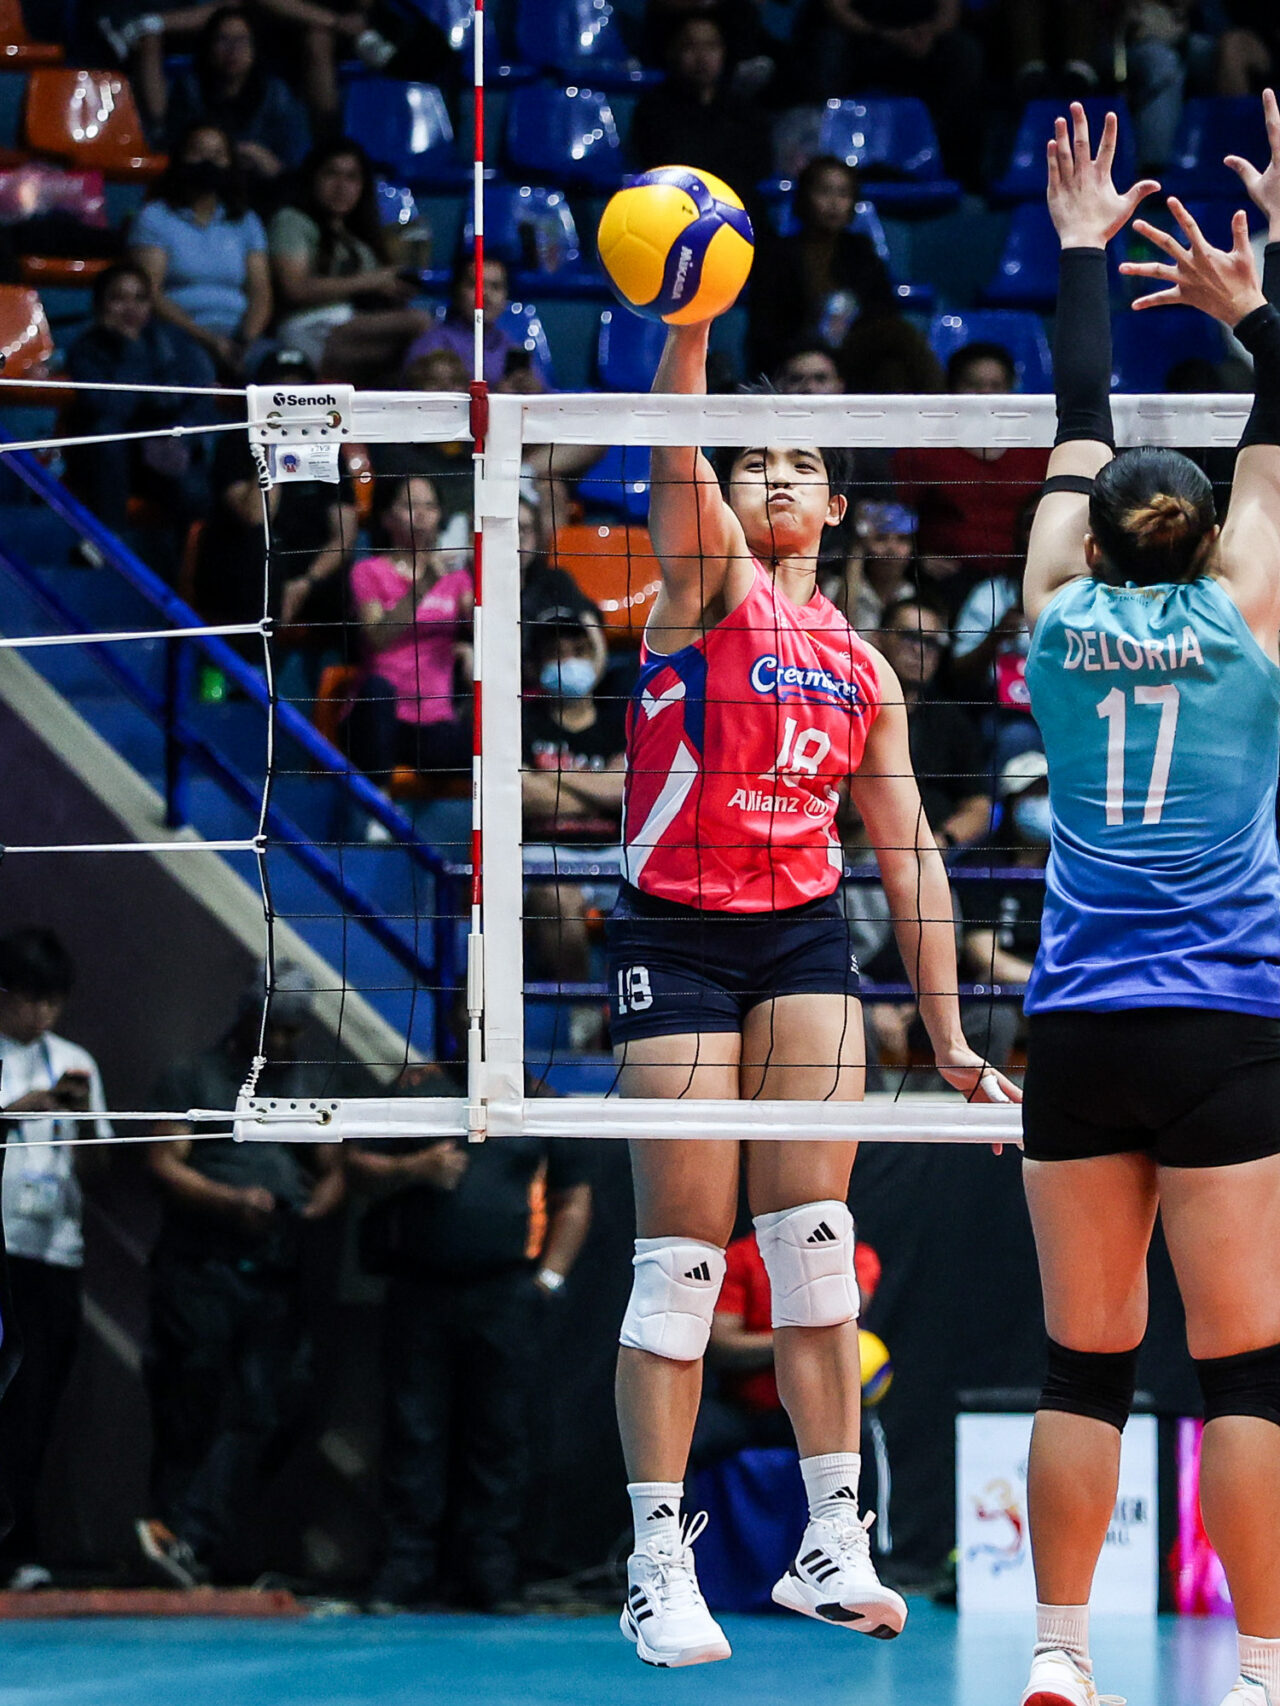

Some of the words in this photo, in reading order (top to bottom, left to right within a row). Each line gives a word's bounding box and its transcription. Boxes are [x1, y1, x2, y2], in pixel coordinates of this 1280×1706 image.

[287, 394, 336, 406] Senoh
[1063, 625, 1205, 671] DELORIA
[751, 656, 857, 697] Creamine
[758, 717, 831, 787] 18
[1096, 684, 1180, 825] 17
[727, 788, 800, 813] Allianz
[617, 966, 653, 1015] 18
